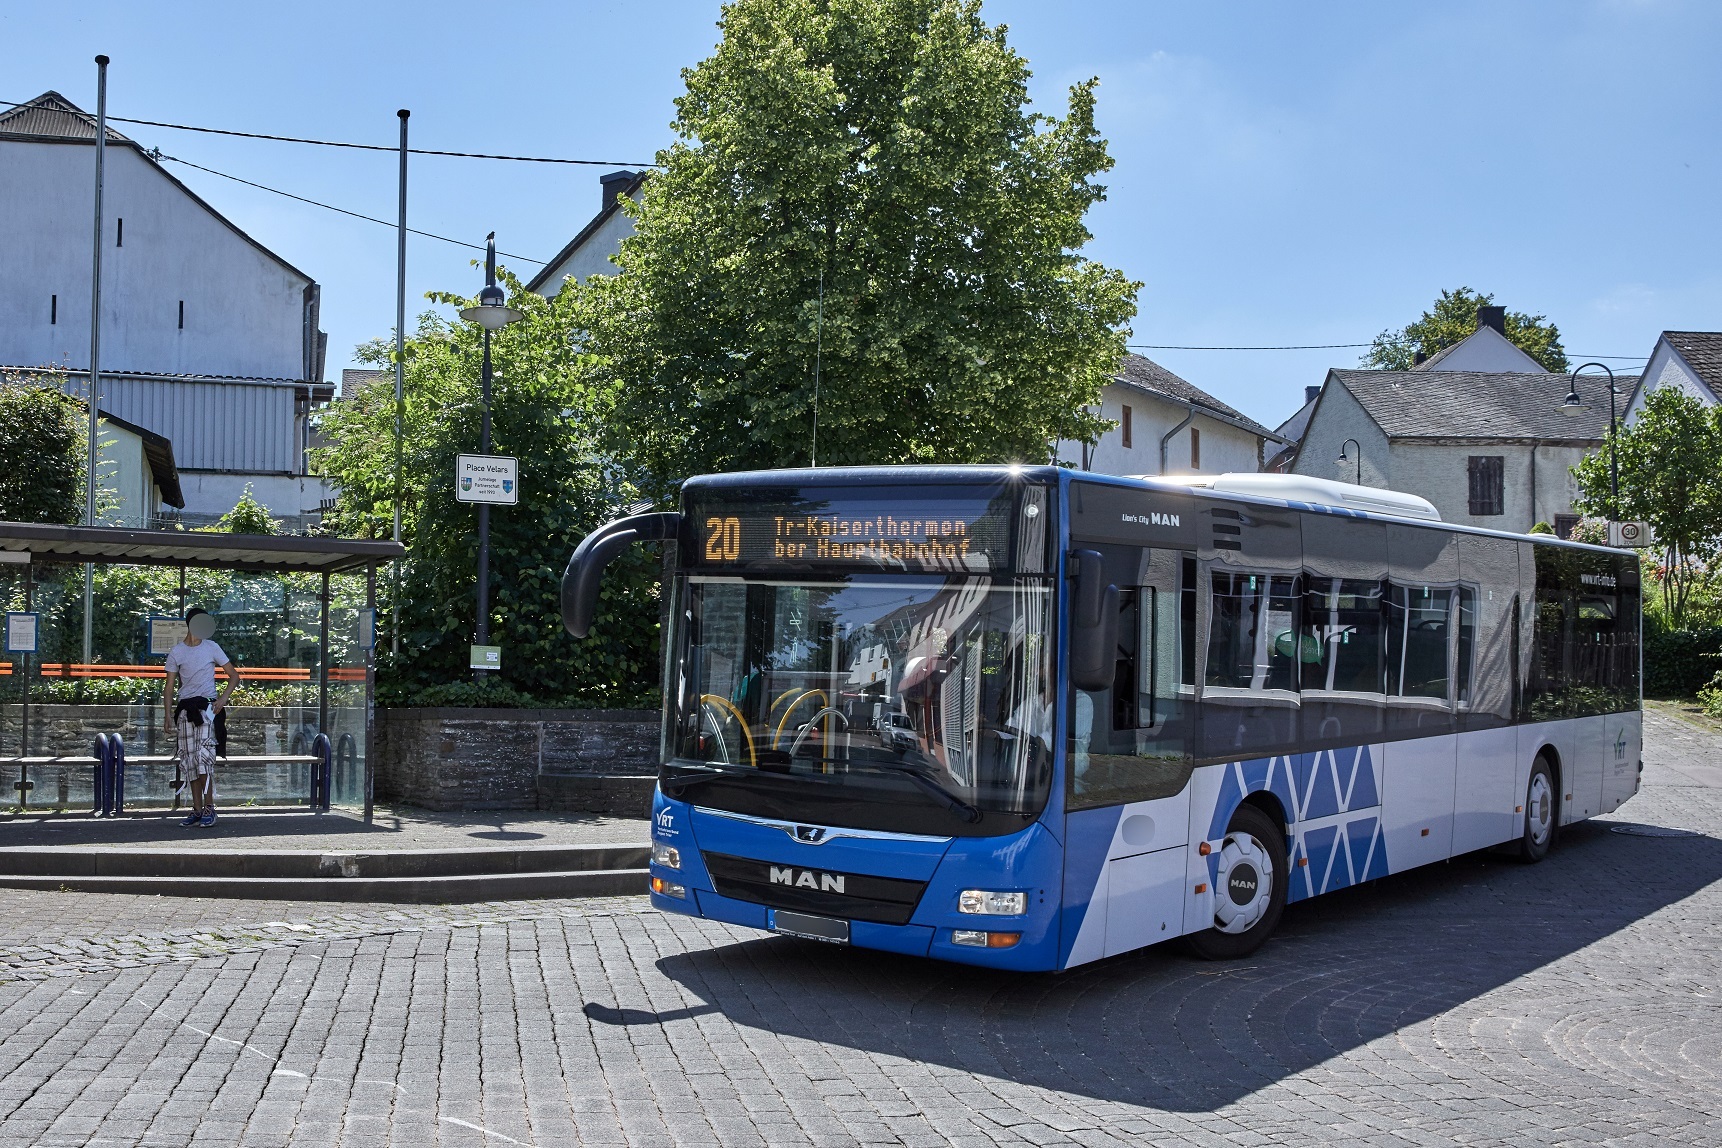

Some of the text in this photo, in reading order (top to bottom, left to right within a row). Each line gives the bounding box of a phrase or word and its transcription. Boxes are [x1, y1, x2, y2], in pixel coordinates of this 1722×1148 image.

[466, 463, 508, 473] Place Velars
[774, 515, 967, 536] Tr-Kaiserthermen
[1122, 512, 1180, 527] Lion's City MAN
[705, 516, 741, 560] 20
[1625, 527, 1636, 536] 30
[774, 538, 970, 560] ber Hauptbahnhof
[1613, 727, 1626, 760] VRT
[656, 805, 674, 828] VRT
[769, 865, 845, 894] MAN
[1230, 879, 1256, 890] MAN
